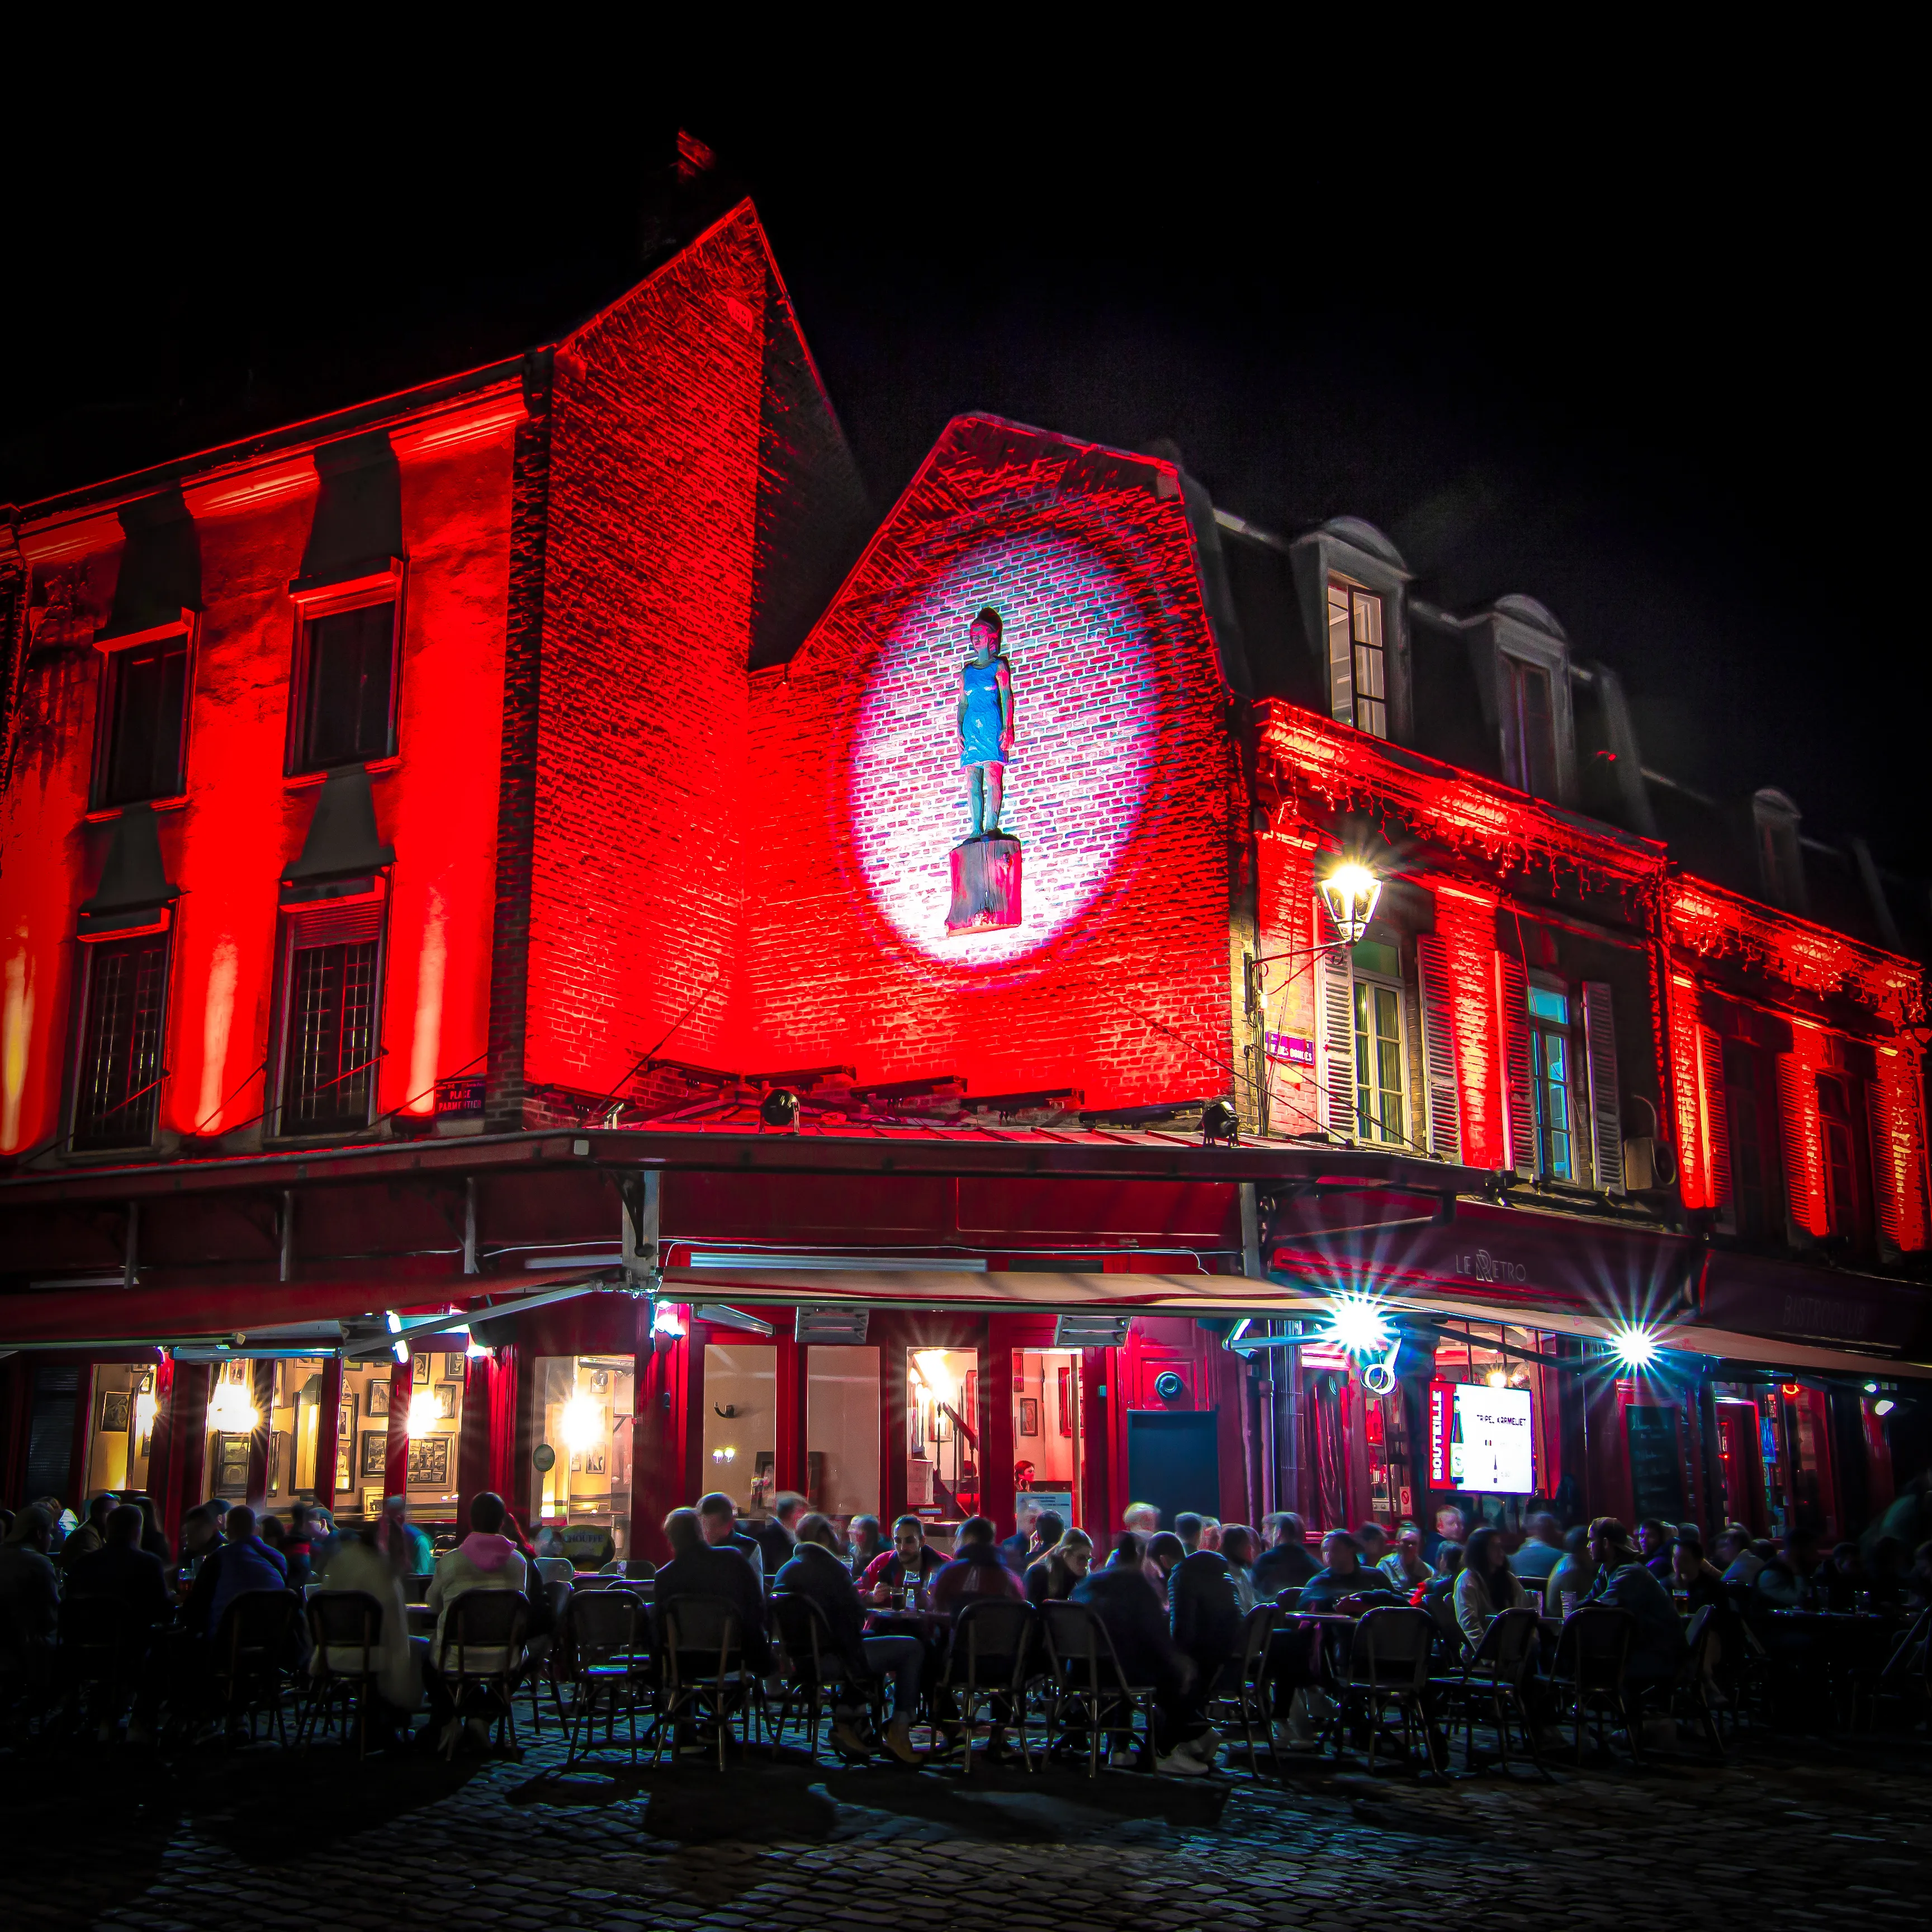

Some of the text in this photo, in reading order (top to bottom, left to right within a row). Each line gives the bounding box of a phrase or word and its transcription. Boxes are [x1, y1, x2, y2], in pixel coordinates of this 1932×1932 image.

[450, 1090, 471, 1100] PLACE
[1456, 1255, 1471, 1275] LE
[1432, 1390, 1444, 1480] BOUTEILLE
